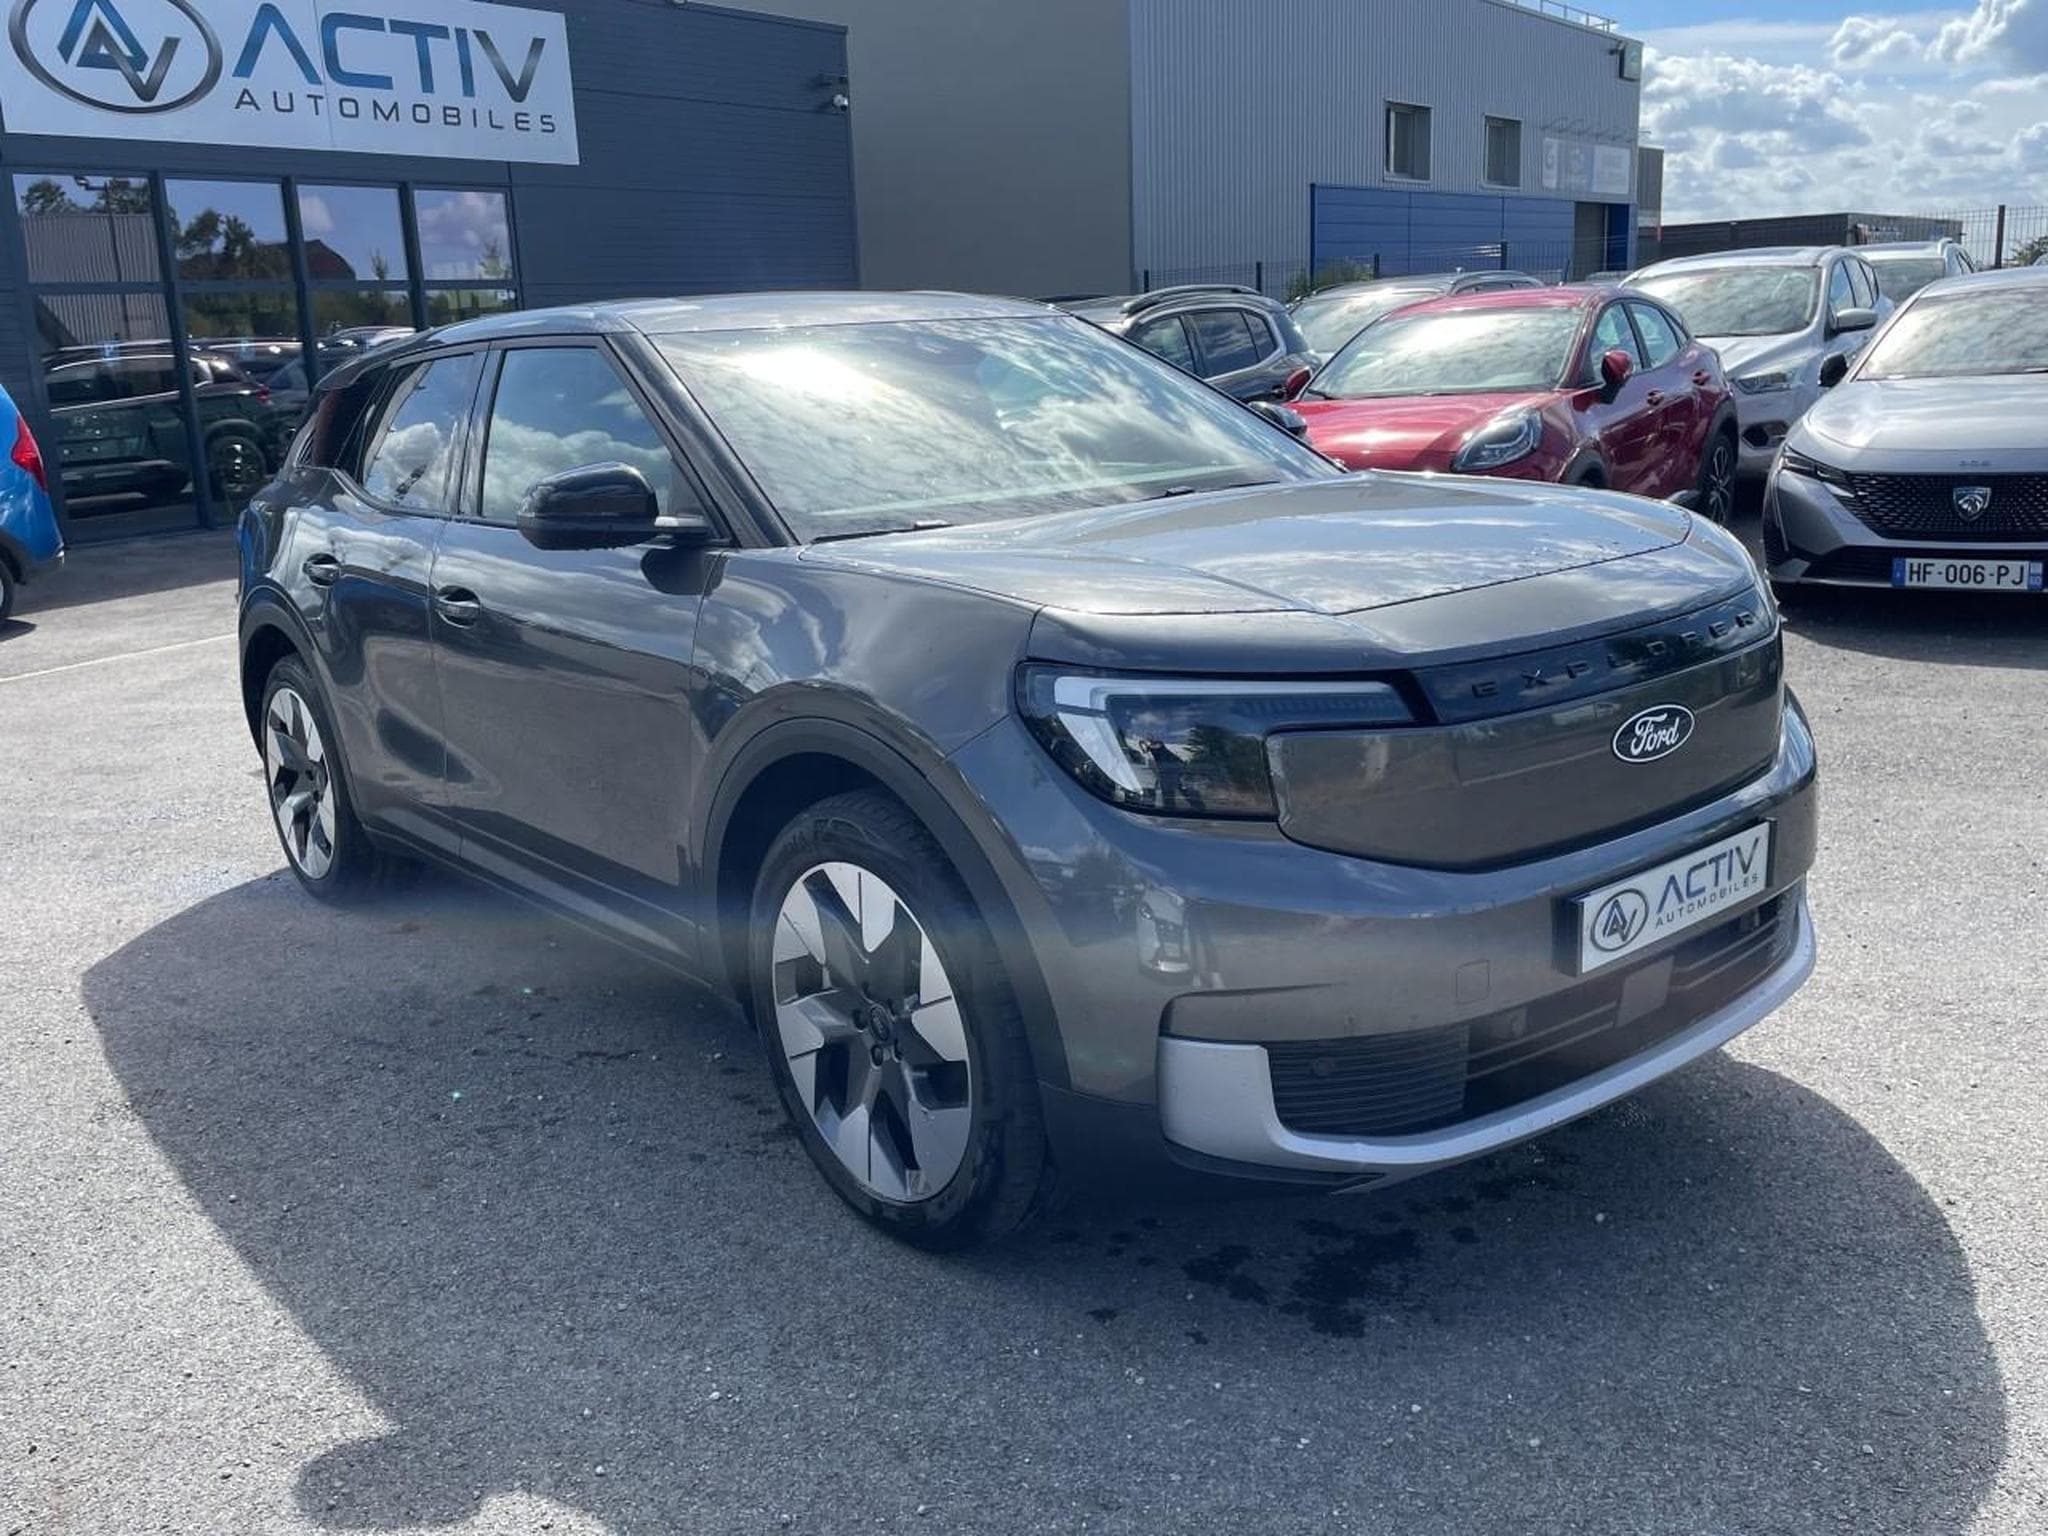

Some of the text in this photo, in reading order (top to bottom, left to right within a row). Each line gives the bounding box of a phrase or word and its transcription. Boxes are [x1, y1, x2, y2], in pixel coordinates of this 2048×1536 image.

[231, 2, 546, 103] ACTIV
[233, 88, 556, 134] AUTOMOBILES
[1908, 563, 2025, 586] HF-006-PJ
[1471, 610, 1755, 698] EXPLORER
[1630, 713, 1680, 756] Ford
[1655, 873, 1759, 929] AUTOMOBILES
[1656, 837, 1760, 915] ACTIV
